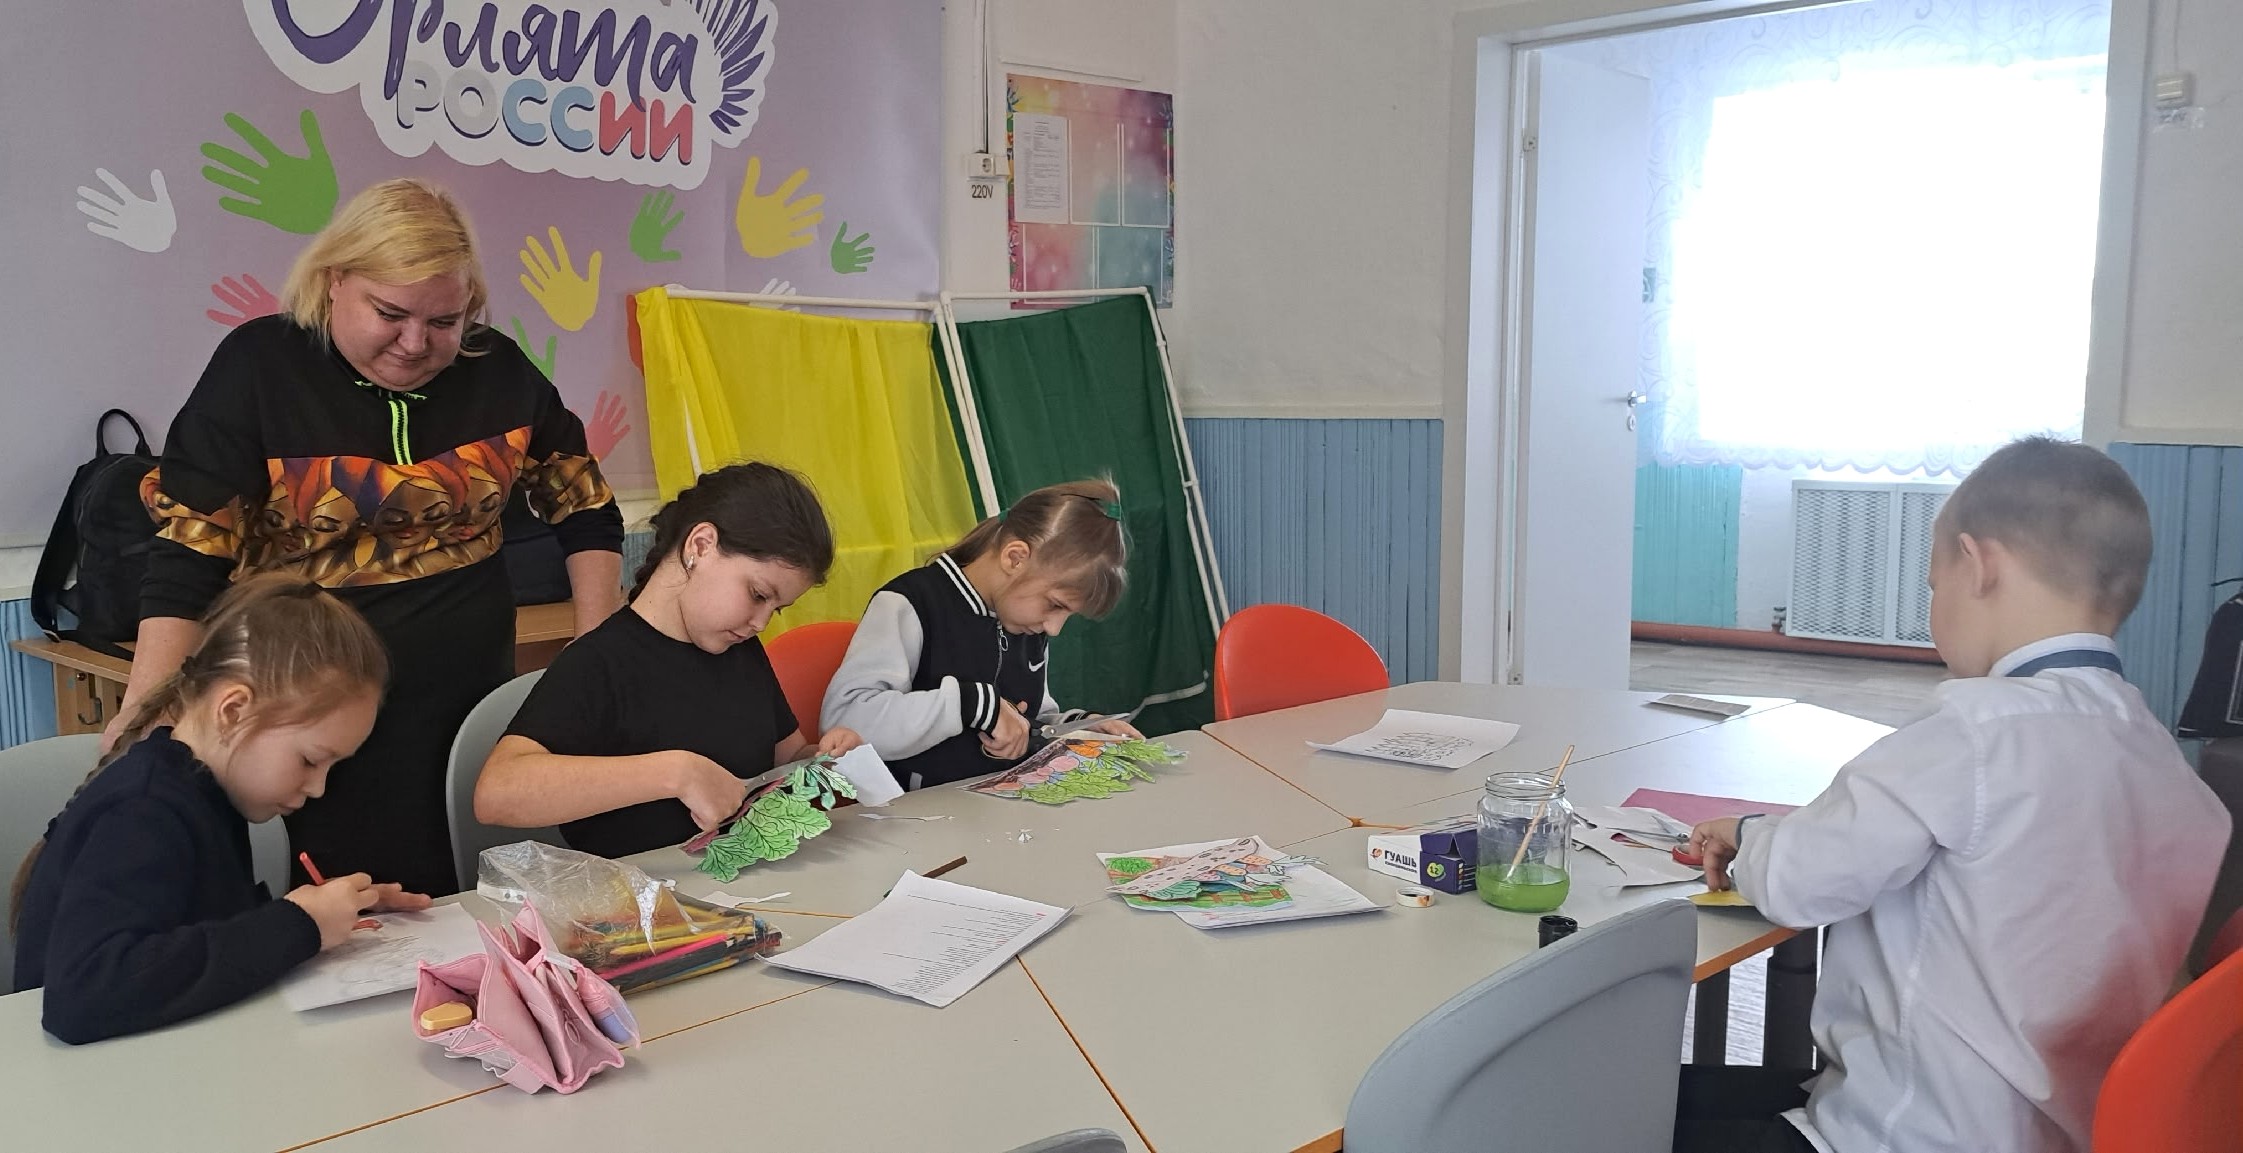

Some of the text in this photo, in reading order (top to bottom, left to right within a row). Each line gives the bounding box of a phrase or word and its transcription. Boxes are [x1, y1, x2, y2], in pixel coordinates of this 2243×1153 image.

[396, 60, 693, 165] РОССИИ
[971, 184, 994, 199] 220V
[1384, 850, 1417, 868] ГУАШЬ
